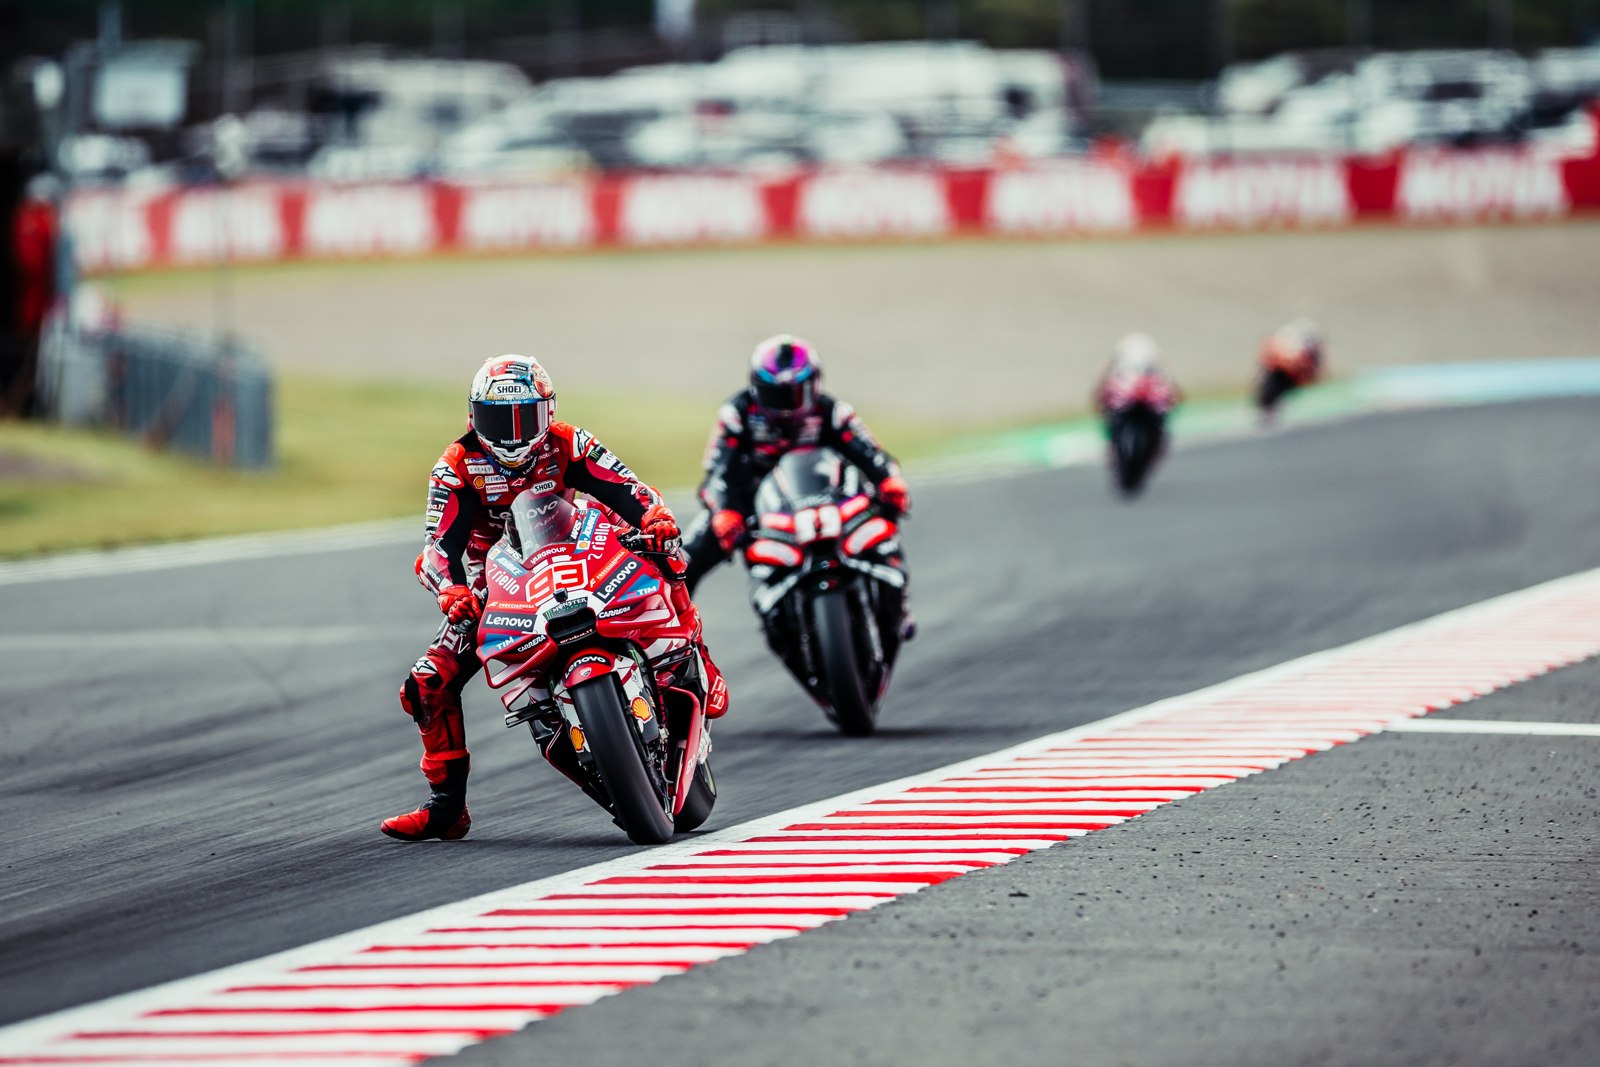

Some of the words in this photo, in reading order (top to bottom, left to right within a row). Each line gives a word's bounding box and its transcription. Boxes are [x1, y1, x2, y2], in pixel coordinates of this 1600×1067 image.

[497, 385, 522, 394] SHOEI
[499, 467, 512, 476] TIM
[534, 481, 553, 492] SHOEI
[592, 522, 611, 551] riello
[491, 570, 520, 595] riello
[525, 559, 589, 603] 93
[597, 561, 638, 600] Lenovo
[637, 585, 657, 596] TIM
[486, 614, 533, 628] Lenovo
[496, 636, 514, 650] TIM
[517, 634, 546, 652] CARRERA
[565, 656, 606, 678] Lenovo
